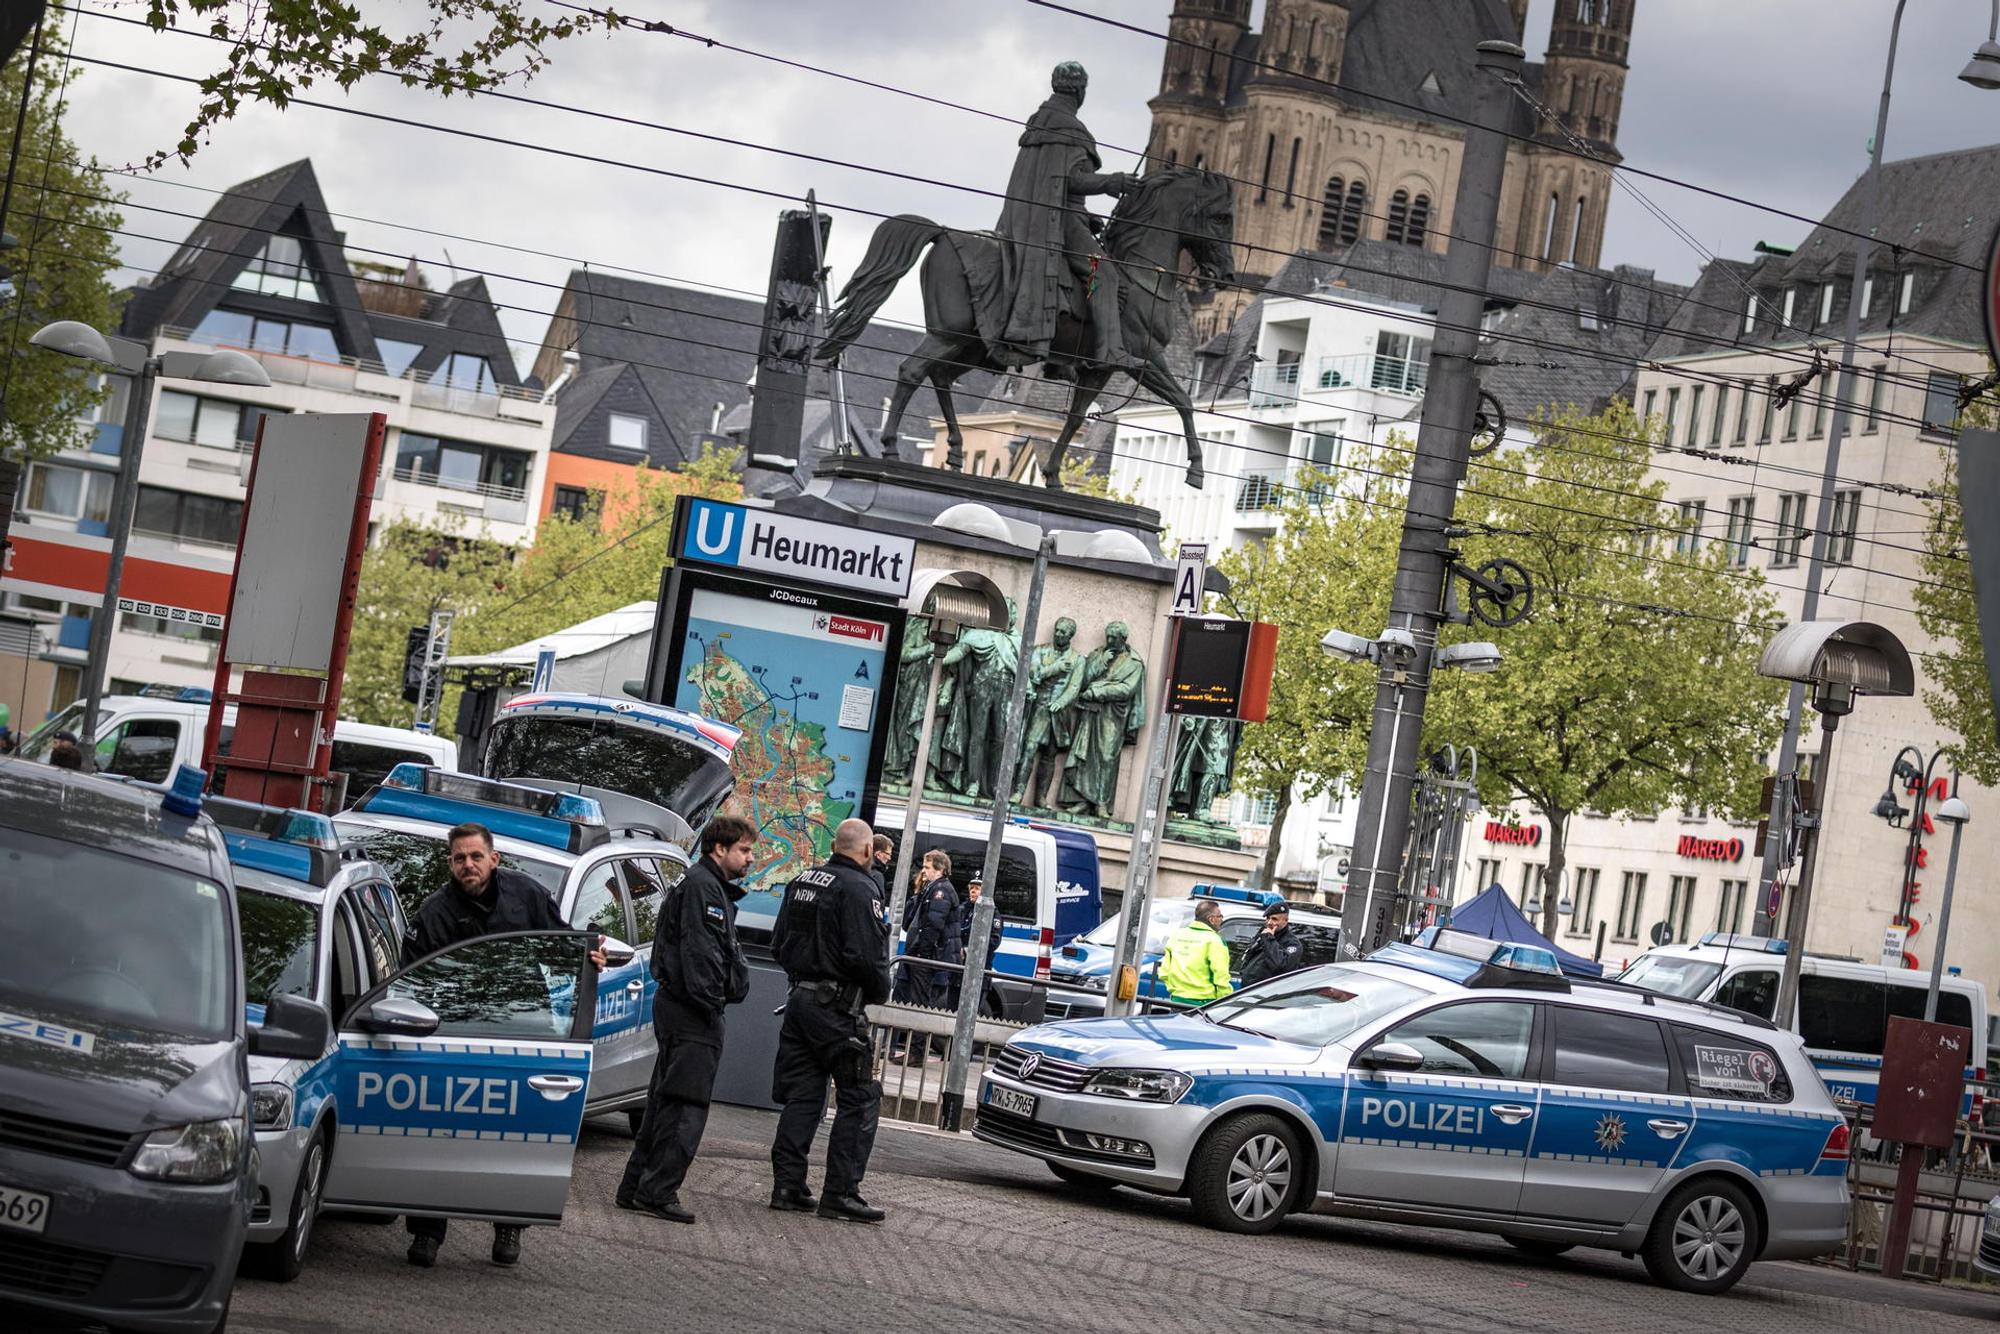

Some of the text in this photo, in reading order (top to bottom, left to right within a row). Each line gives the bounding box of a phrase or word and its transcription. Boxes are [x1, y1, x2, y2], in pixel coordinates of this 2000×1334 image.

[696, 507, 903, 582] U Heumarkt
[1181, 550, 1204, 563] Bussteig
[1176, 567, 1195, 608] A
[769, 589, 818, 606] JCDecaux
[137, 603, 150, 614] 132
[155, 606, 168, 616] 133
[831, 621, 867, 636] Stadt Köln
[1485, 821, 1541, 847] MAREDO
[1677, 835, 1743, 863] MAREDO
[795, 869, 836, 888] POLIZEI
[794, 888, 817, 903] NRW
[1701, 1051, 1745, 1067] Riegel
[1714, 1066, 1742, 1078] vor!
[356, 1072, 518, 1116] POLIZEI
[1362, 1097, 1484, 1135] POLIZEI
